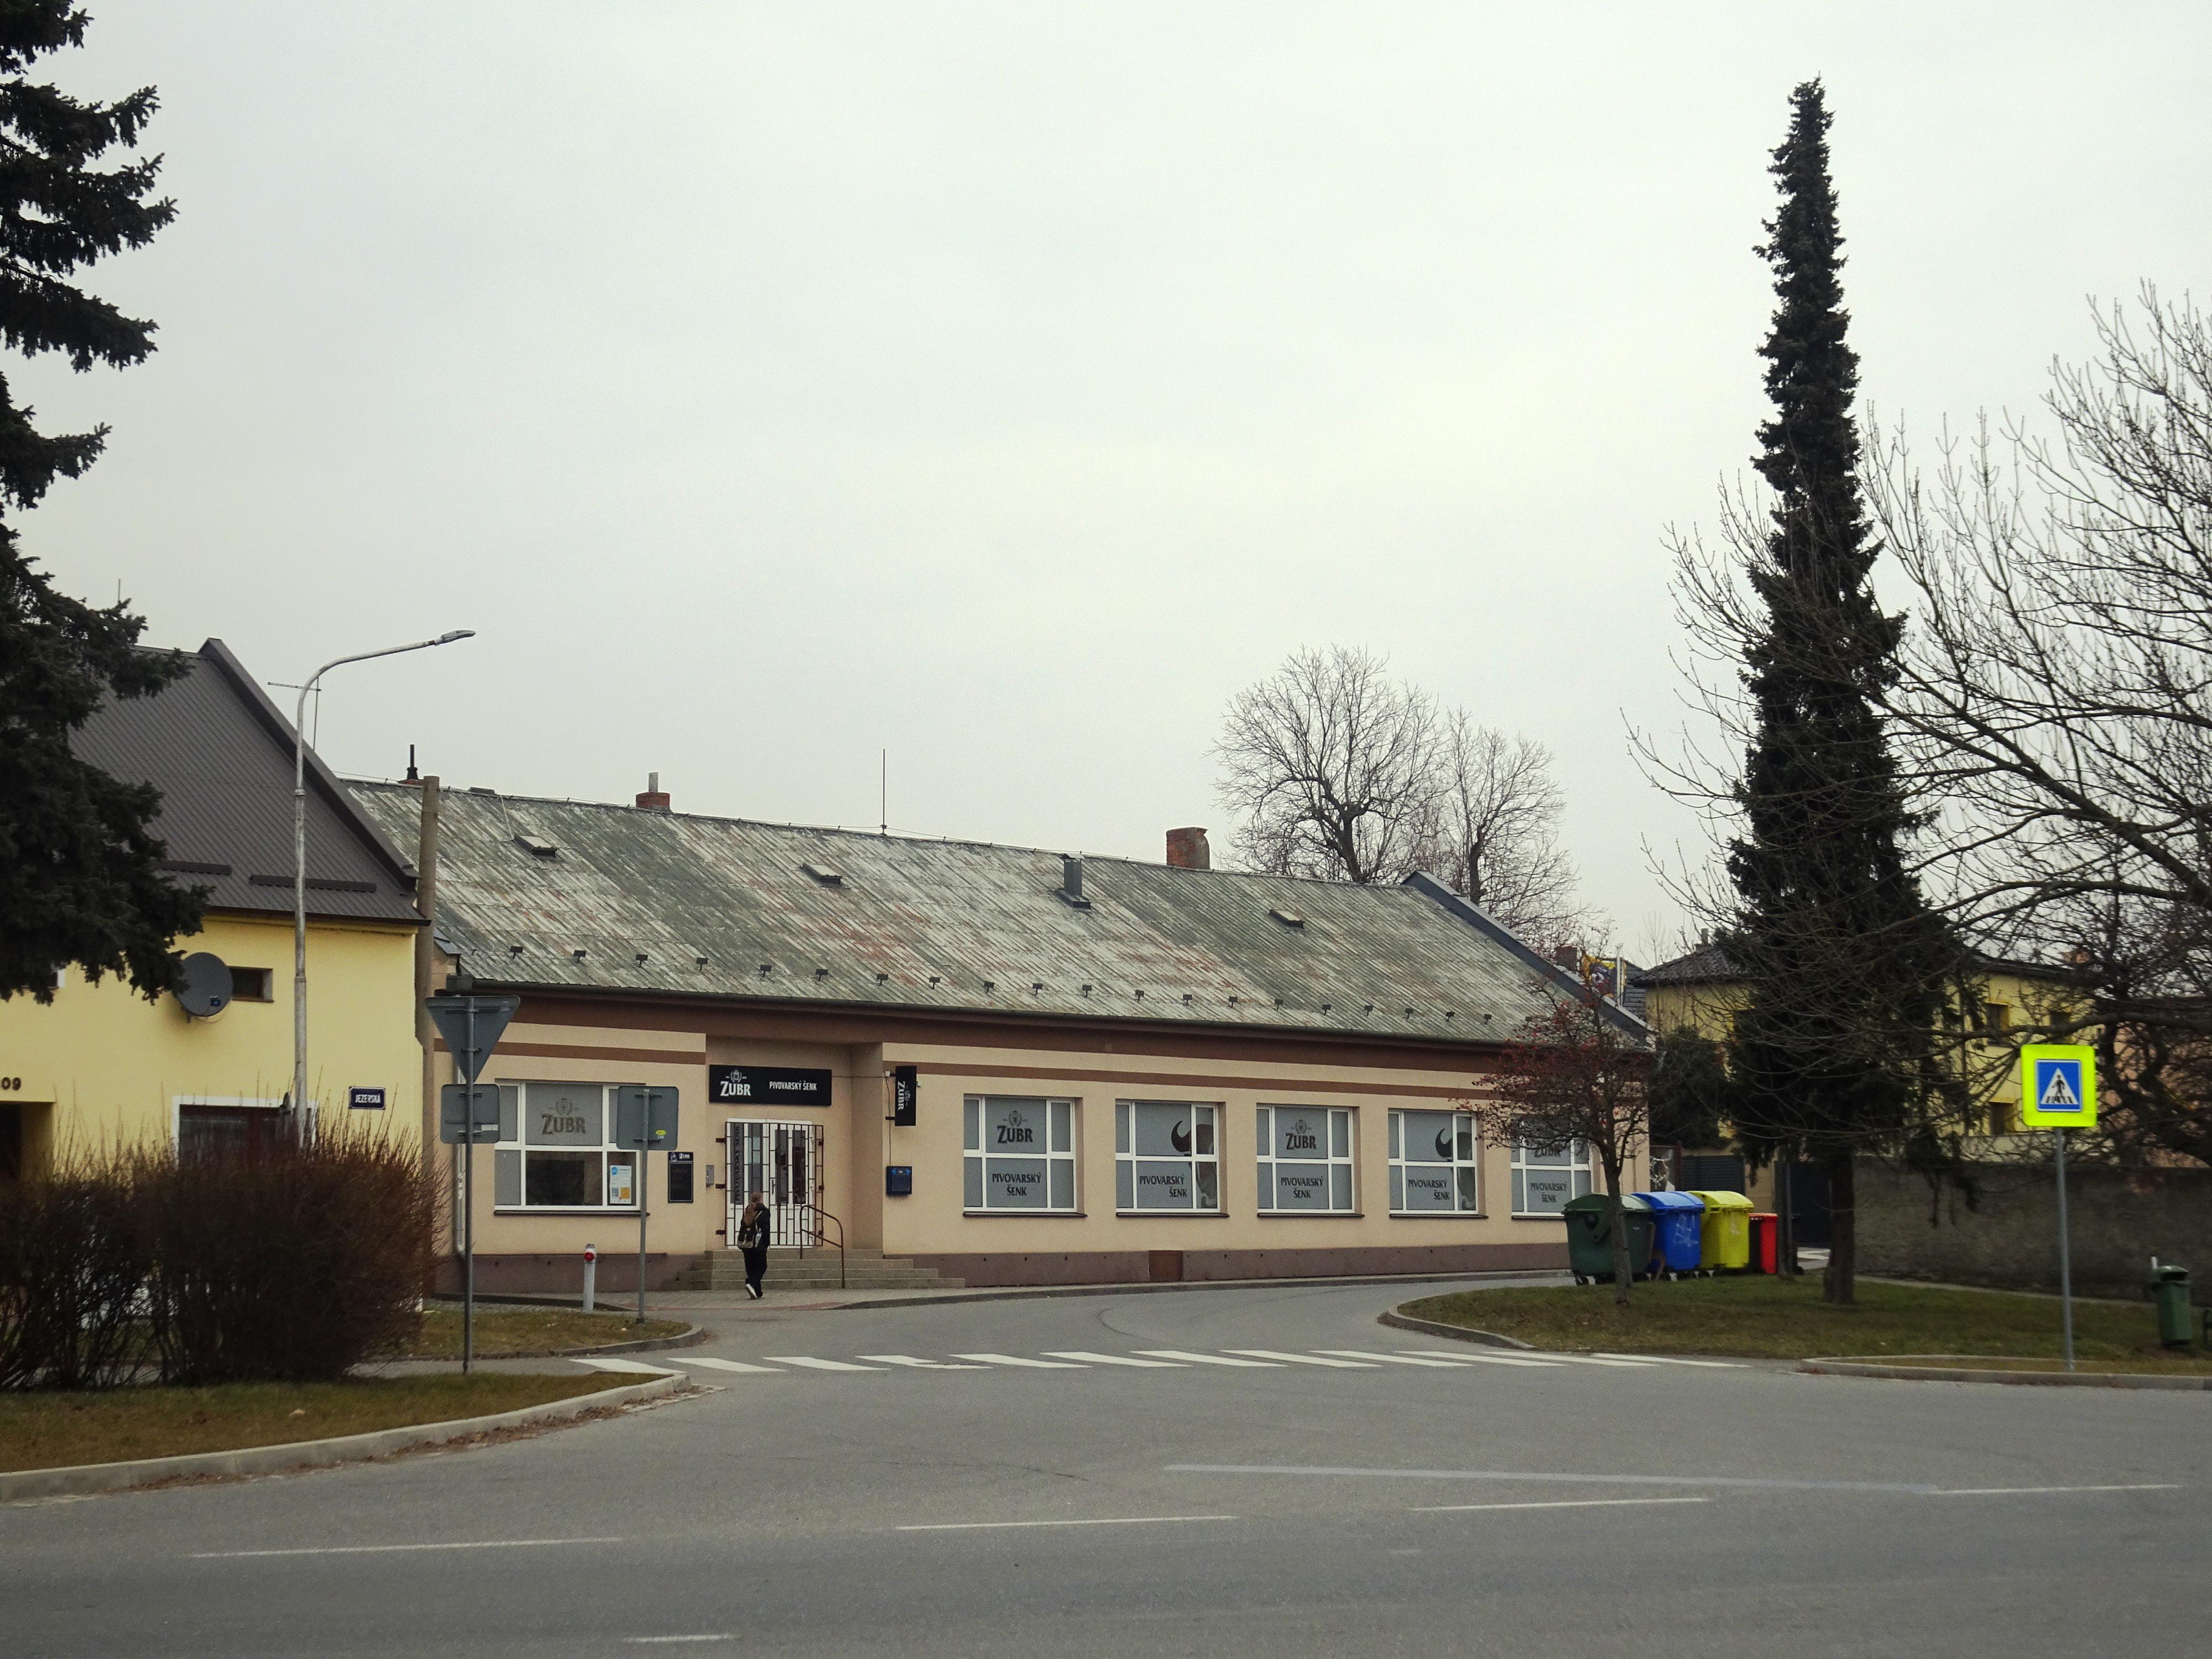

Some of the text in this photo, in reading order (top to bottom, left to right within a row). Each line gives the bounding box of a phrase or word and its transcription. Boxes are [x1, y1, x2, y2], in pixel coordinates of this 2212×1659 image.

[719, 1081, 752, 1097] ZUBR
[769, 1080, 817, 1091] PIVOVARSKÝ ŠENK
[541, 1114, 586, 1135] ZUBR
[997, 1125, 1034, 1144] ZUBR
[1285, 1132, 1317, 1150] ZUBR
[992, 1172, 1041, 1183] PIVOVARSKÝ
[1139, 1173, 1185, 1185] PIVOVARSKÝ
[1281, 1176, 1323, 1186] PIVOVARSKÝ
[1408, 1178, 1447, 1188] PIVOVARSKÝ
[1006, 1185, 1027, 1196] ŠENK
[1169, 1186, 1188, 1198] ŠENK
[1293, 1188, 1311, 1198] ŠENK
[1433, 1189, 1450, 1200] ŠENK
[1541, 1192, 1557, 1203] ŠENK
